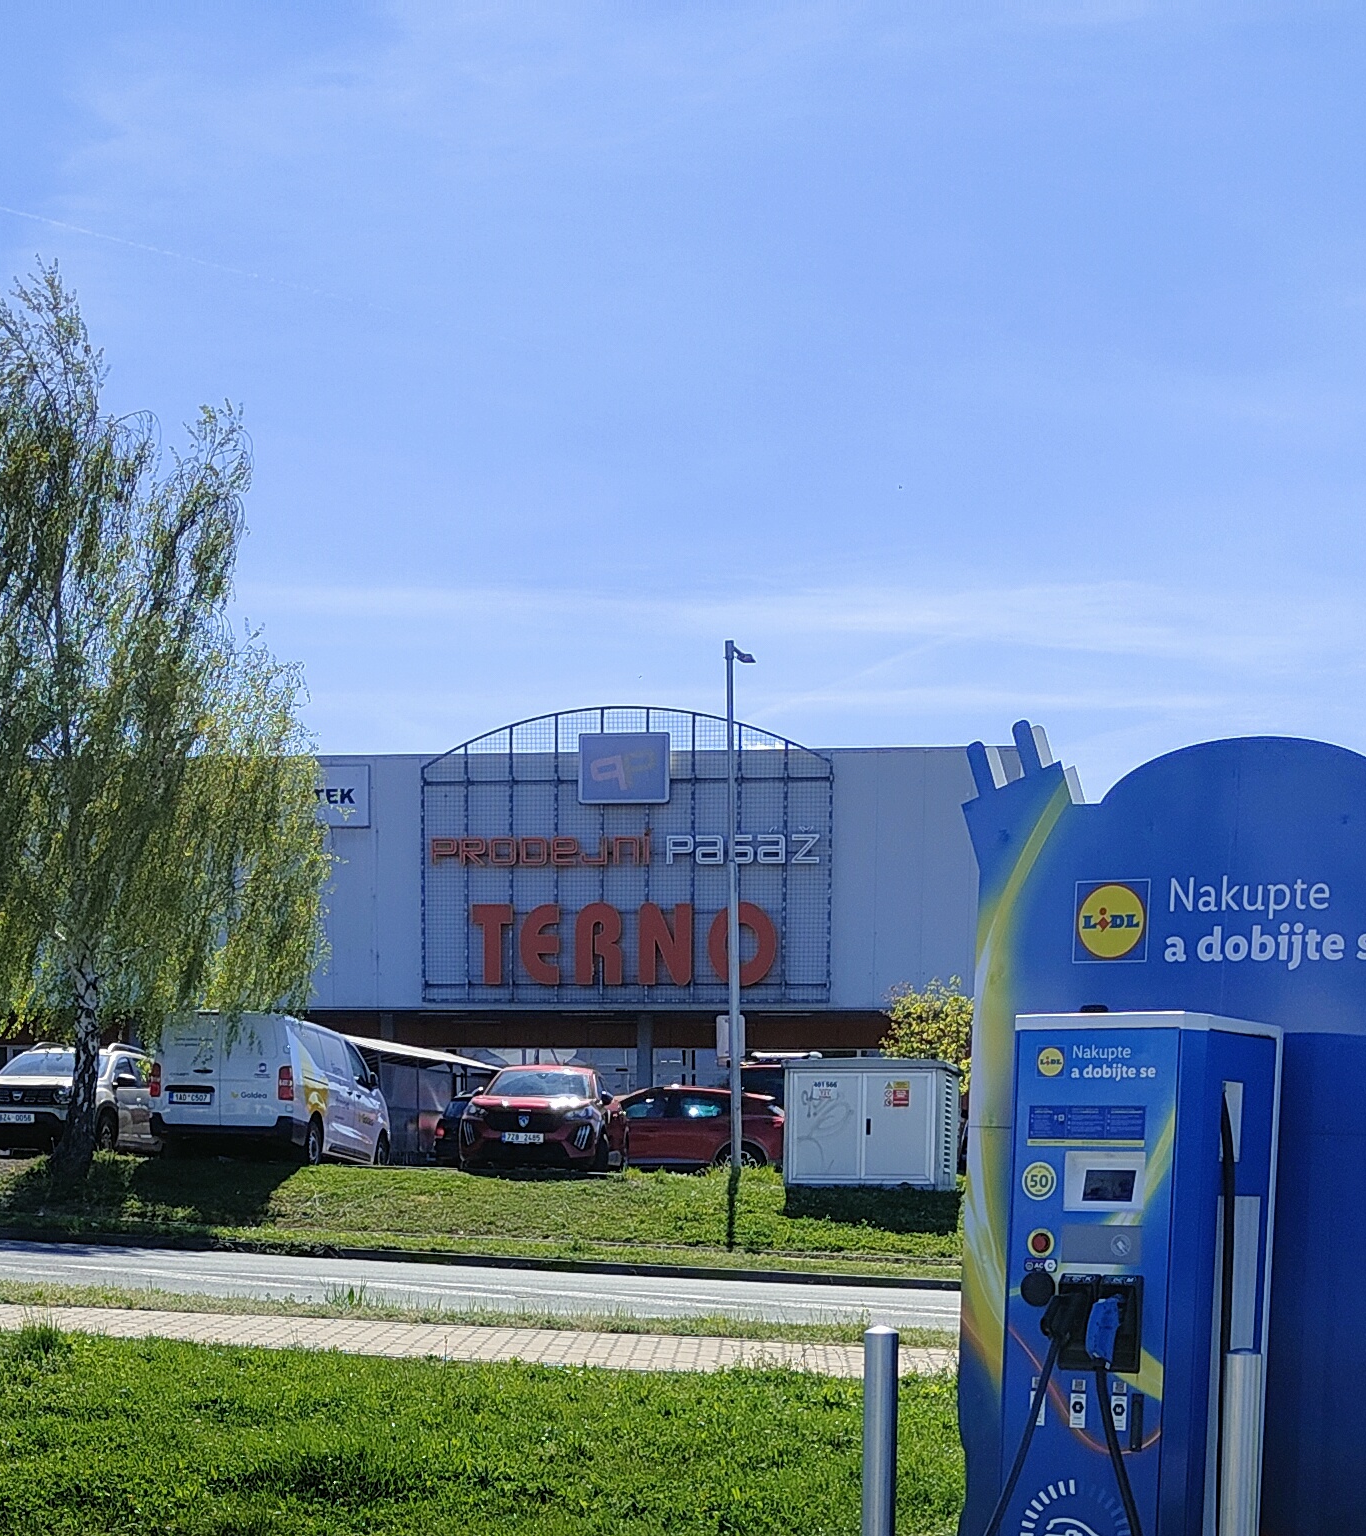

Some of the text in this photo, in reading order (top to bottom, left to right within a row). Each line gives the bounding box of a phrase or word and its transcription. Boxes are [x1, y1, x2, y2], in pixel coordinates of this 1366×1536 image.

[1169, 875, 1330, 919] Nakupte
[472, 902, 776, 987] TERNO
[1164, 936, 1185, 962] a
[1197, 923, 1345, 970] dobijte
[1072, 1045, 1132, 1061] Nakupte
[1071, 1063, 1156, 1081] a dobijte se
[241, 1091, 267, 1099] Goldea
[1029, 1174, 1049, 1189] 50
